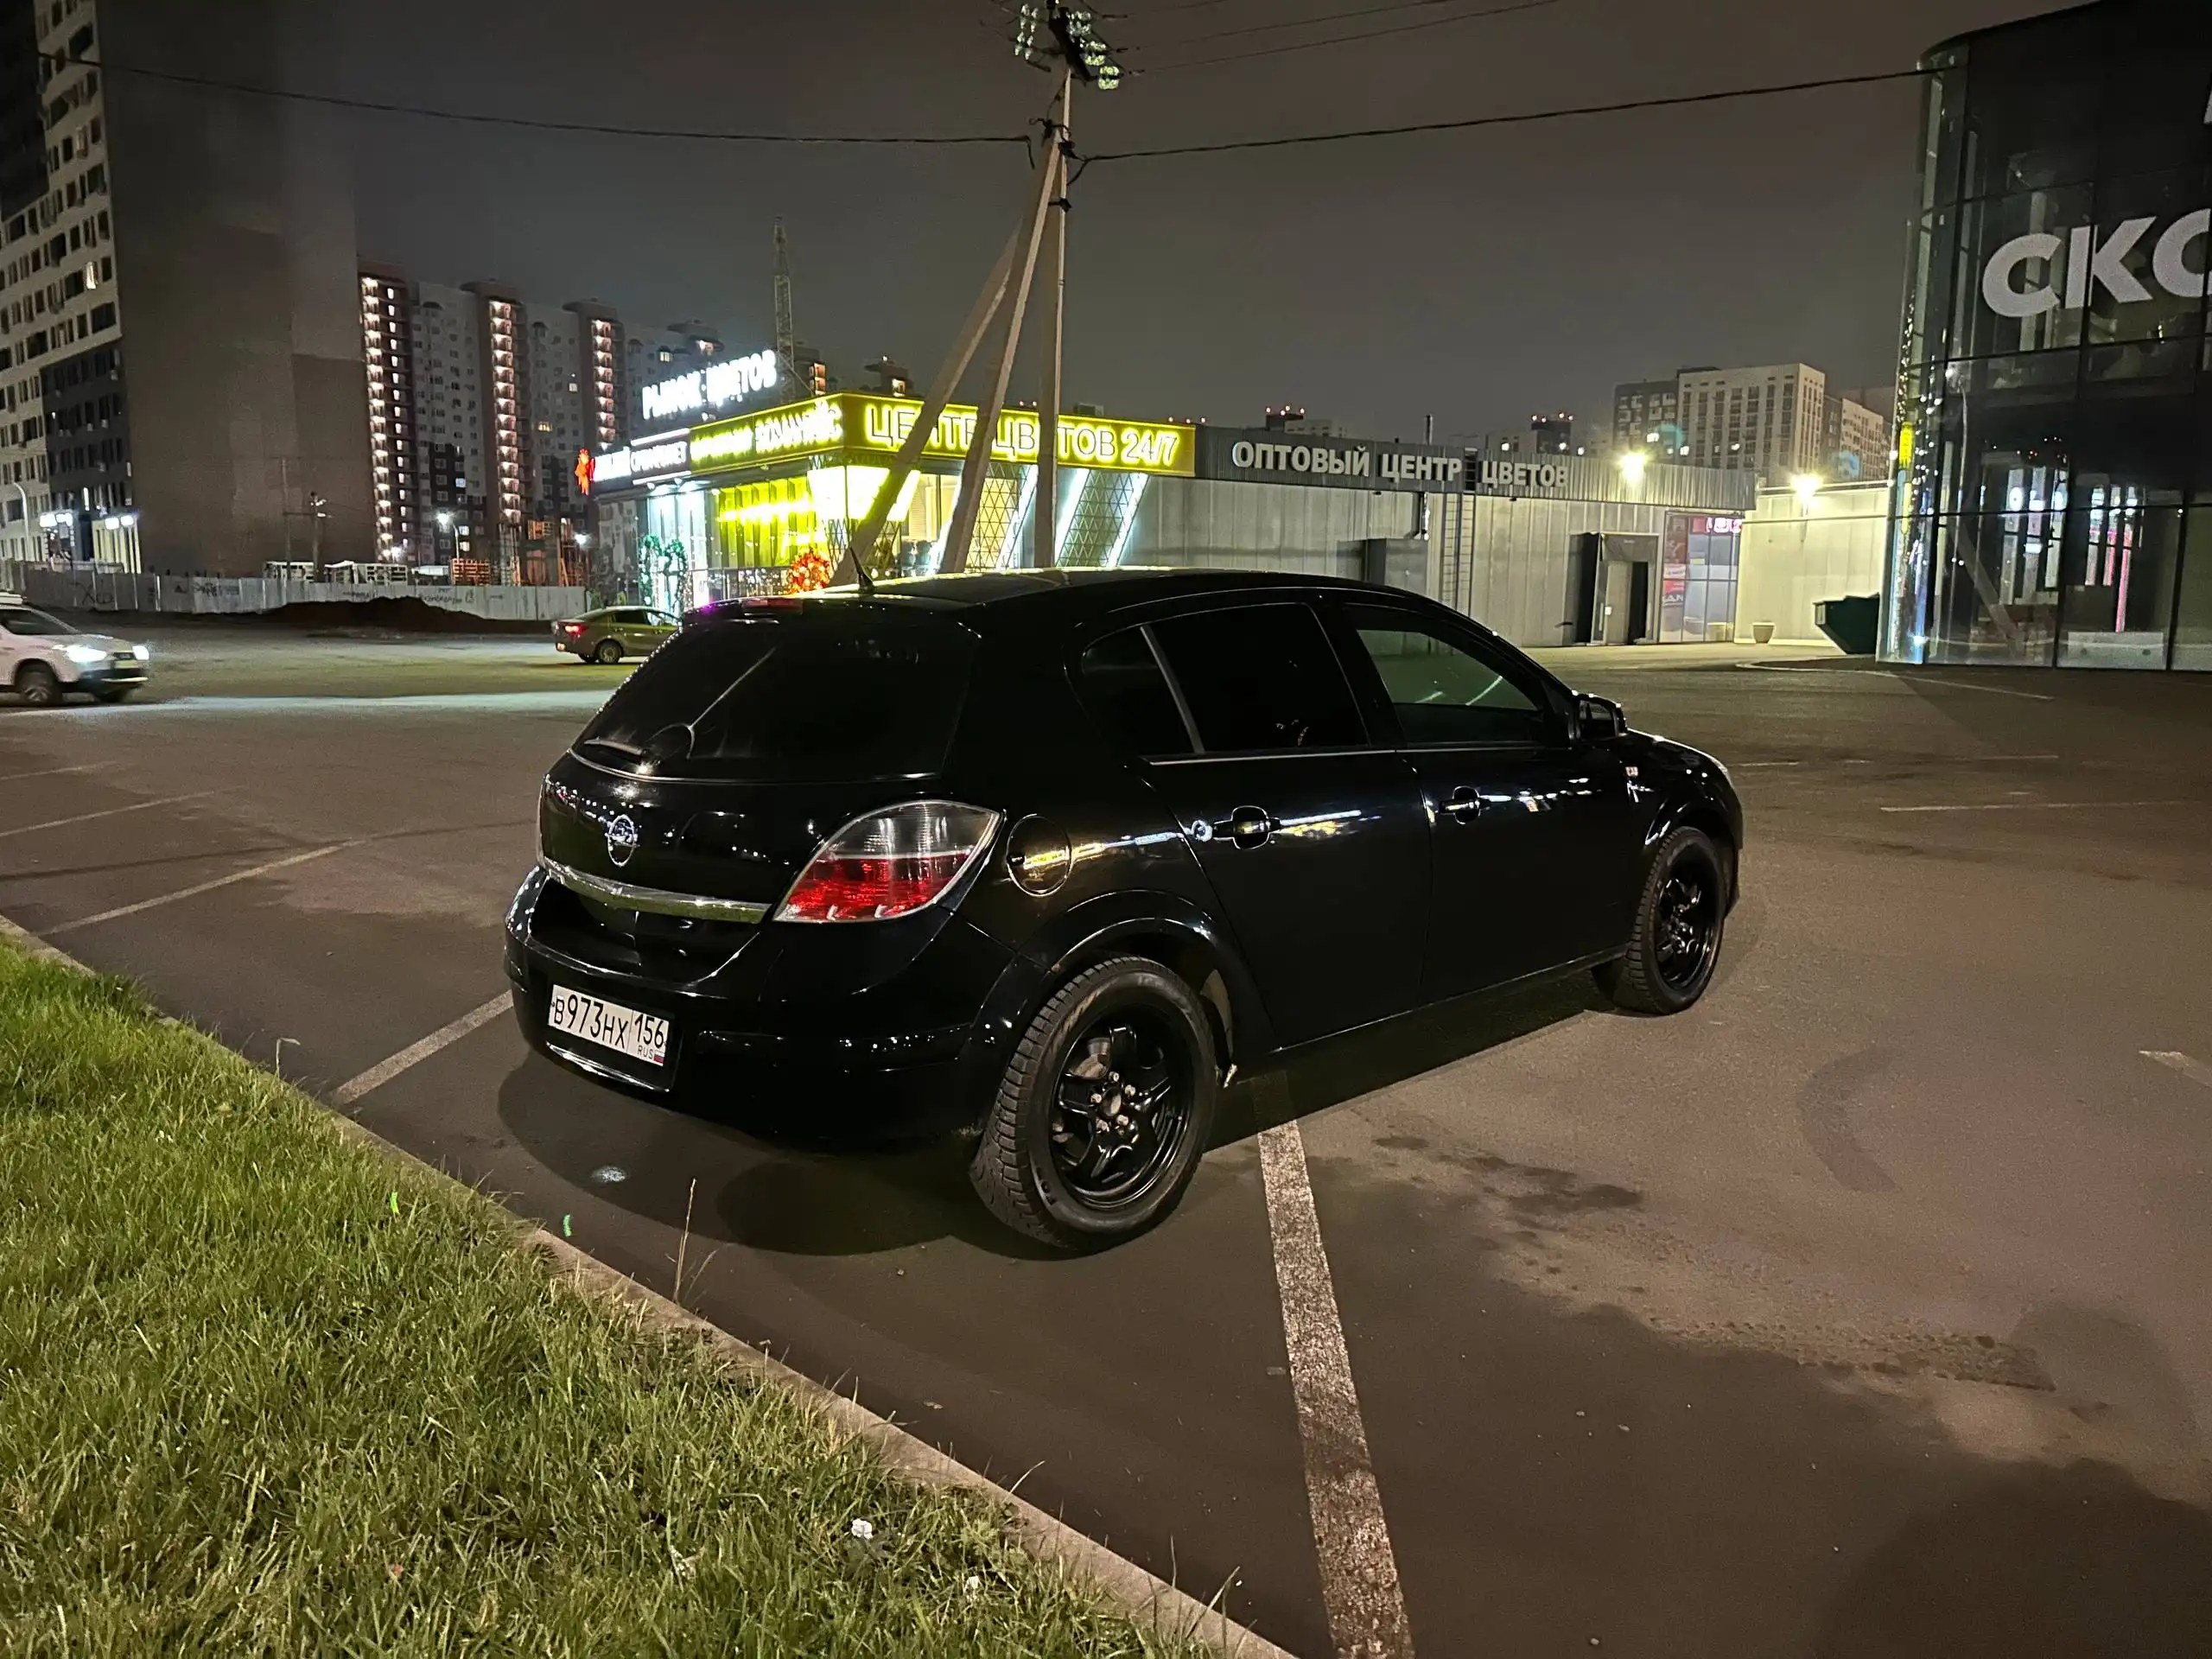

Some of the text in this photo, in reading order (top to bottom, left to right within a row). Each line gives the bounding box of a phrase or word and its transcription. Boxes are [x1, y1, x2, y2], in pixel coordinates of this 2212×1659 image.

[867, 404, 978, 449] ЦЕТР
[994, 417, 1117, 459] ЦВТОВ
[1123, 429, 1179, 465] 24/7
[1232, 442, 1569, 489] ОПТОВЫЙ ЦЕНТР ЦВЕТОВ
[638, 1045, 654, 1059] RUS
